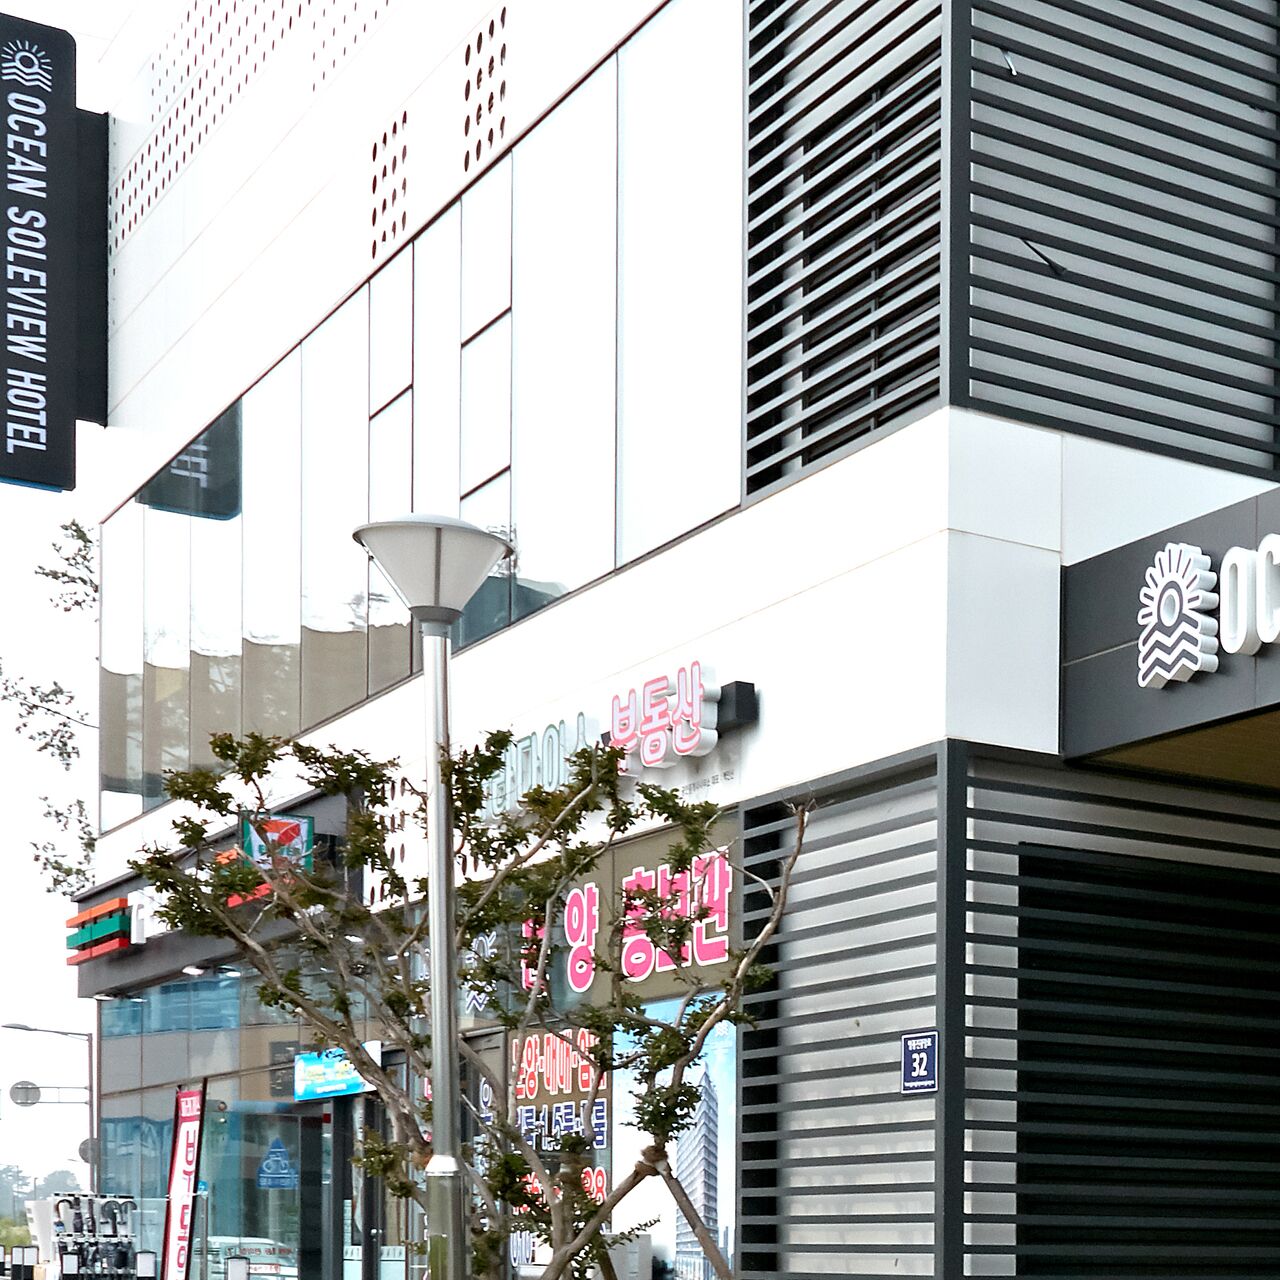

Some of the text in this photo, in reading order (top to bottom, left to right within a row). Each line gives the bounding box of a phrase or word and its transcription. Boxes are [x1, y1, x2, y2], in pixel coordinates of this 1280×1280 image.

[6, 91, 48, 455] OCEAN SOLEVIEW HOTEL
[910, 1051, 929, 1078] 32
